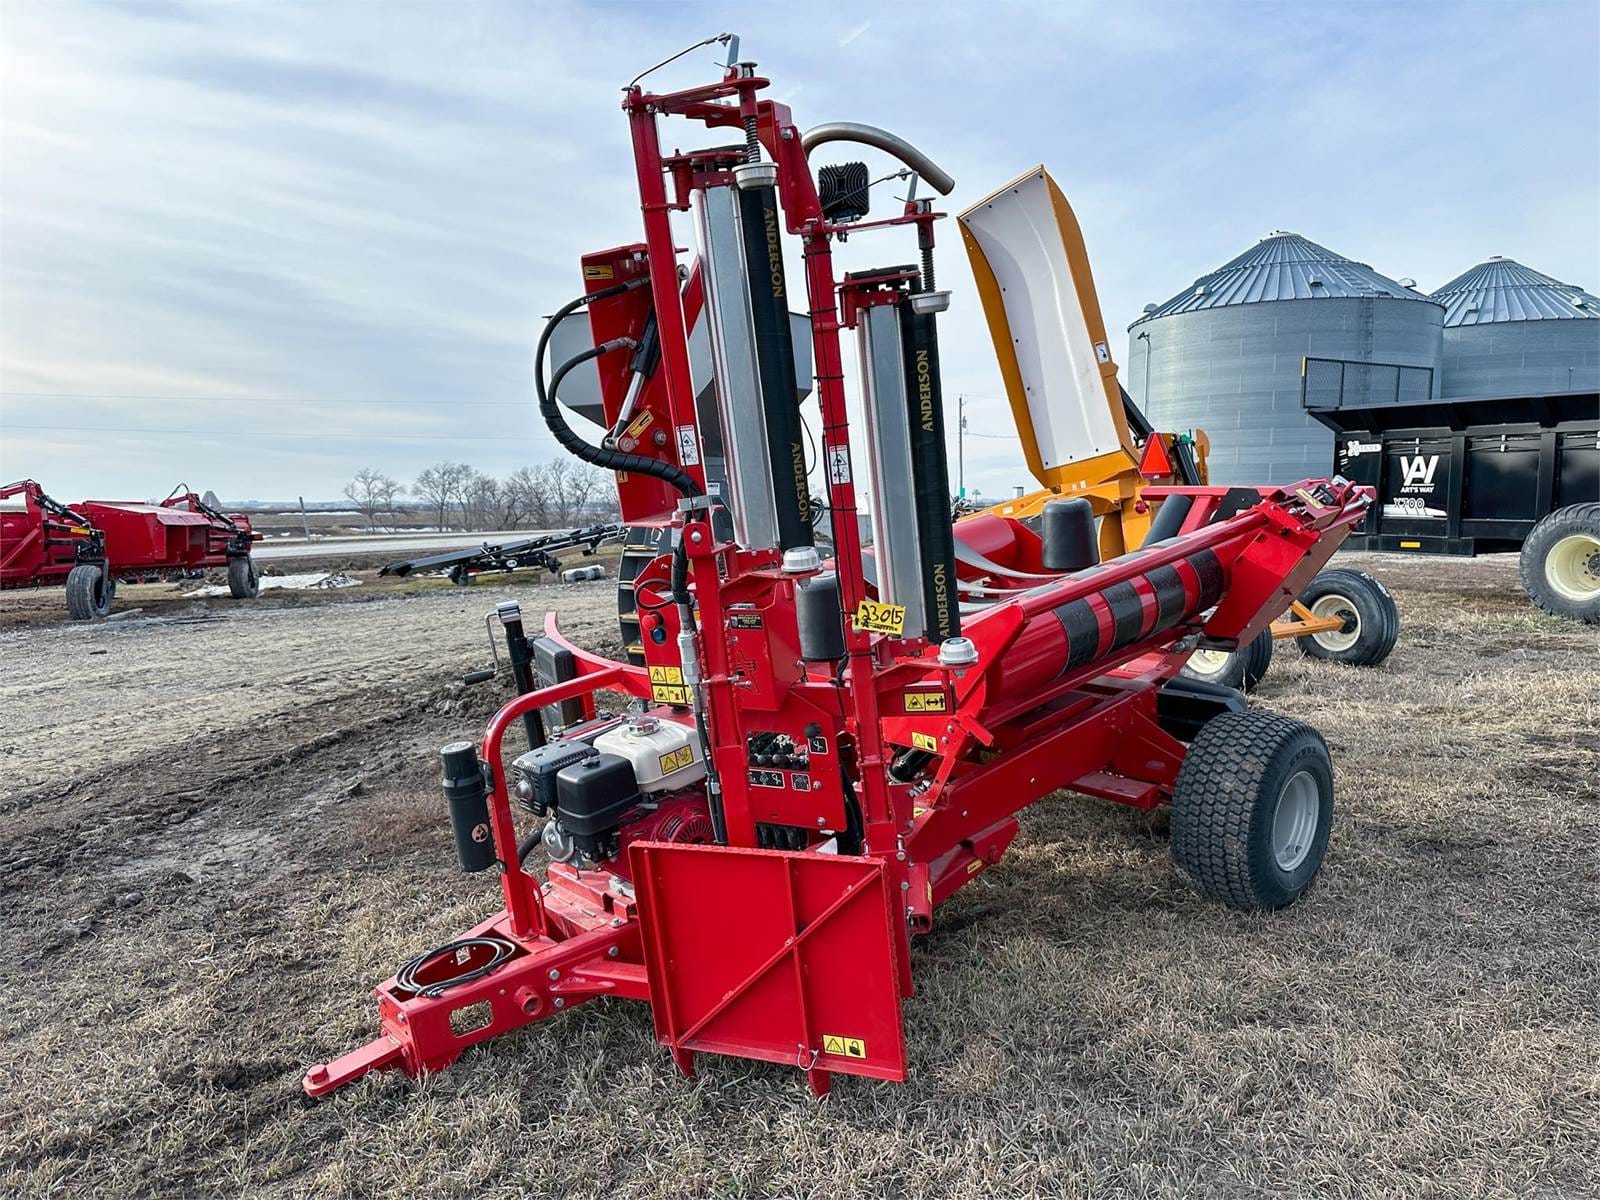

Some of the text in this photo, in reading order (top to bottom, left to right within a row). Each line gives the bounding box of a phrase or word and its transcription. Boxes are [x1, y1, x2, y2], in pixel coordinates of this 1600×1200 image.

[763, 208, 783, 297] ANDERSON
[916, 350, 934, 431] ANDERSON
[791, 442, 809, 522] ANDERSON
[861, 604, 904, 625] 23015
[934, 564, 950, 637] ANDERSON
